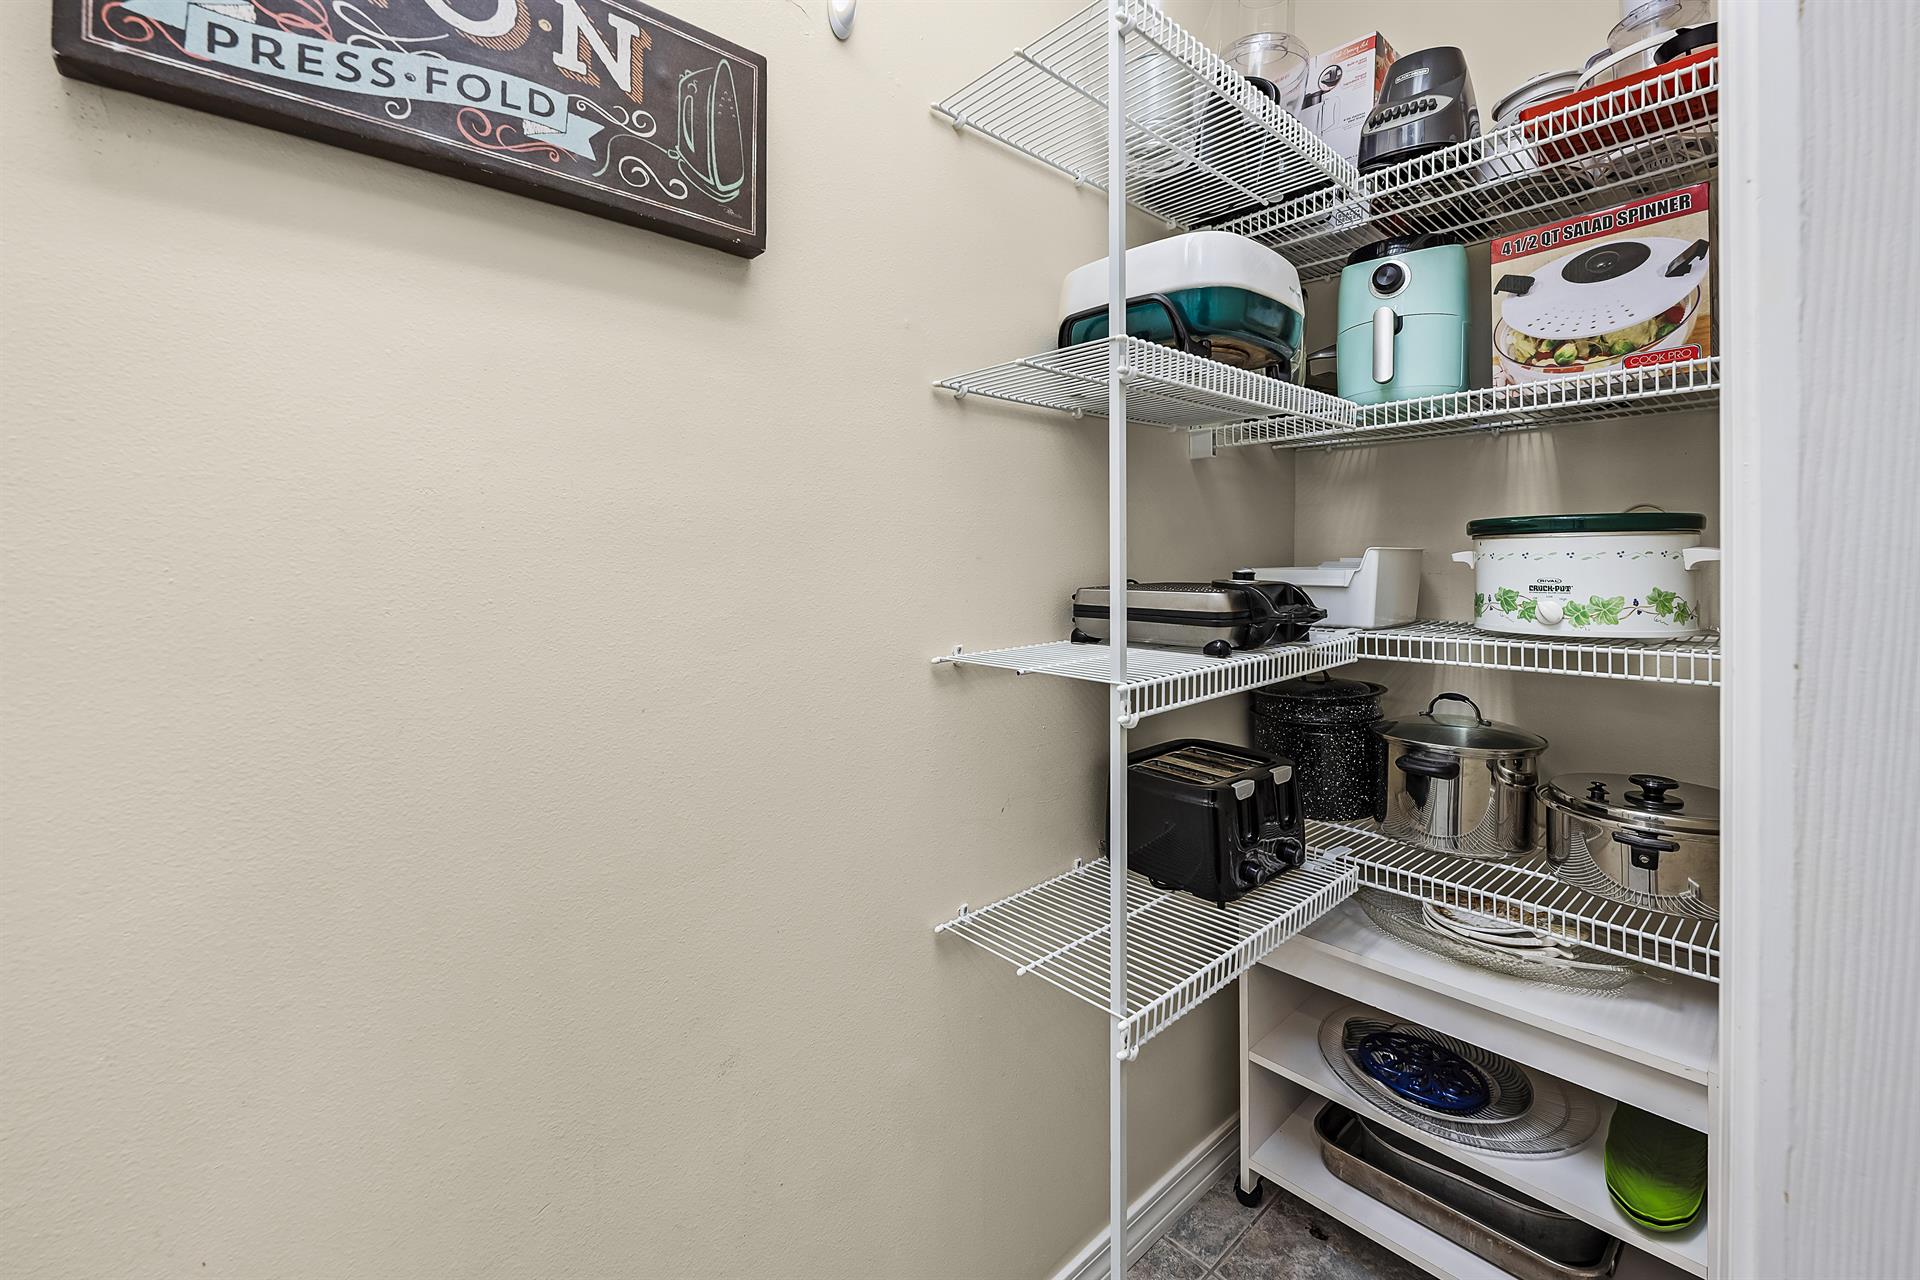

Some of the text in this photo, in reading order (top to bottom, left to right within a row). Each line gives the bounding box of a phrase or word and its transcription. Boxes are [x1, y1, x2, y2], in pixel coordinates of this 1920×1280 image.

[1501, 193, 1692, 256] 4 1/2 QT SALAD SPINNER
[1630, 348, 1692, 366] COOK PRO
